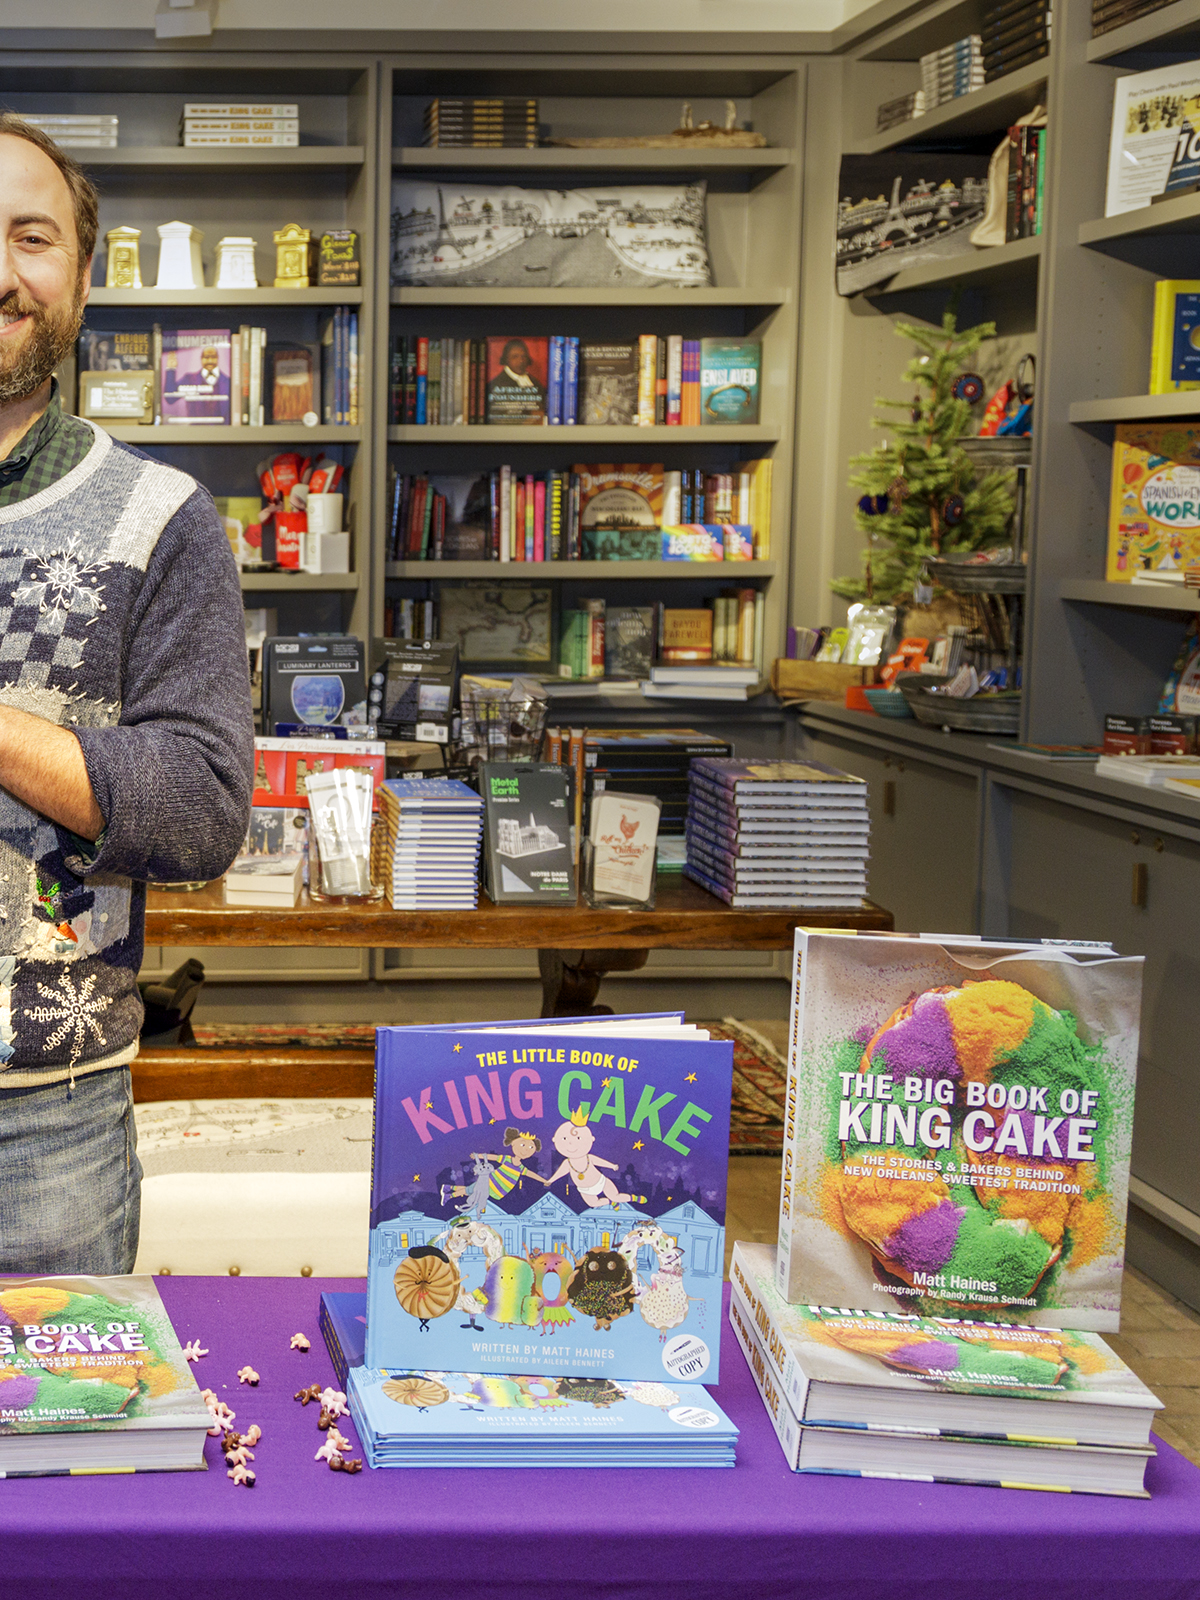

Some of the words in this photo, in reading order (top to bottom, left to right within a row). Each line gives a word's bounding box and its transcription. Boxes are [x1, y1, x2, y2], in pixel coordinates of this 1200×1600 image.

[115, 334, 148, 344] ENRIQUE
[162, 335, 230, 348] MONUMENTAL
[702, 368, 756, 386] ENSLAVED
[491, 778, 518, 786] Metal
[491, 787, 519, 795] Earth
[476, 1052, 507, 1067] THE
[513, 1049, 565, 1063] LITTLE
[570, 1050, 614, 1068] BOOK
[618, 1057, 638, 1072] OF
[839, 1072, 893, 1100] THE
[904, 1076, 955, 1104] BIG
[967, 1081, 1049, 1113] BOOK
[1060, 1089, 1099, 1115] OF
[401, 1068, 544, 1144] KING
[557, 1070, 712, 1157] CAKE
[786, 1076, 797, 1141] KING
[838, 1100, 952, 1150] KING
[962, 1112, 1097, 1160] CAKE
[862, 1155, 886, 1166] THE
[890, 1157, 942, 1171] STORIES
[947, 1161, 957, 1172] &
[960, 1163, 1011, 1177] BAKERS
[1016, 1168, 1064, 1180] BEHIND
[782, 1155, 794, 1219] CAKE
[844, 1166, 872, 1177] NEW
[942, 1174, 1009, 1187] SWEETEST
[1013, 1180, 1081, 1194] TRADITION
[913, 1271, 946, 1287] Matt
[950, 1275, 997, 1291] Haines
[873, 1282, 925, 1297] Photography
[927, 1288, 937, 1298] by
[940, 1289, 966, 1301] Randy
[969, 1291, 998, 1302] Krause
[1001, 1295, 1037, 1305] Schmidt
[24, 1324, 97, 1335] BOOK
[107, 1322, 140, 1333] OF
[755, 1299, 770, 1341] KING
[770, 1327, 786, 1374] CAKE
[25, 1333, 149, 1353] CAKE
[472, 1343, 520, 1353] WRITTEN
[524, 1346, 538, 1354] BY
[543, 1346, 572, 1356] MATT
[576, 1348, 615, 1358] HAINES
[30, 1356, 78, 1364] BAKERS
[480, 1355, 529, 1363] ILLUSTRATED
[544, 1358, 565, 1366] AILEEN
[568, 1359, 605, 1367] BENNETT
[678, 1357, 704, 1378] COPY
[1, 1408, 34, 1417] Matt
[38, 1407, 85, 1416] Haines
